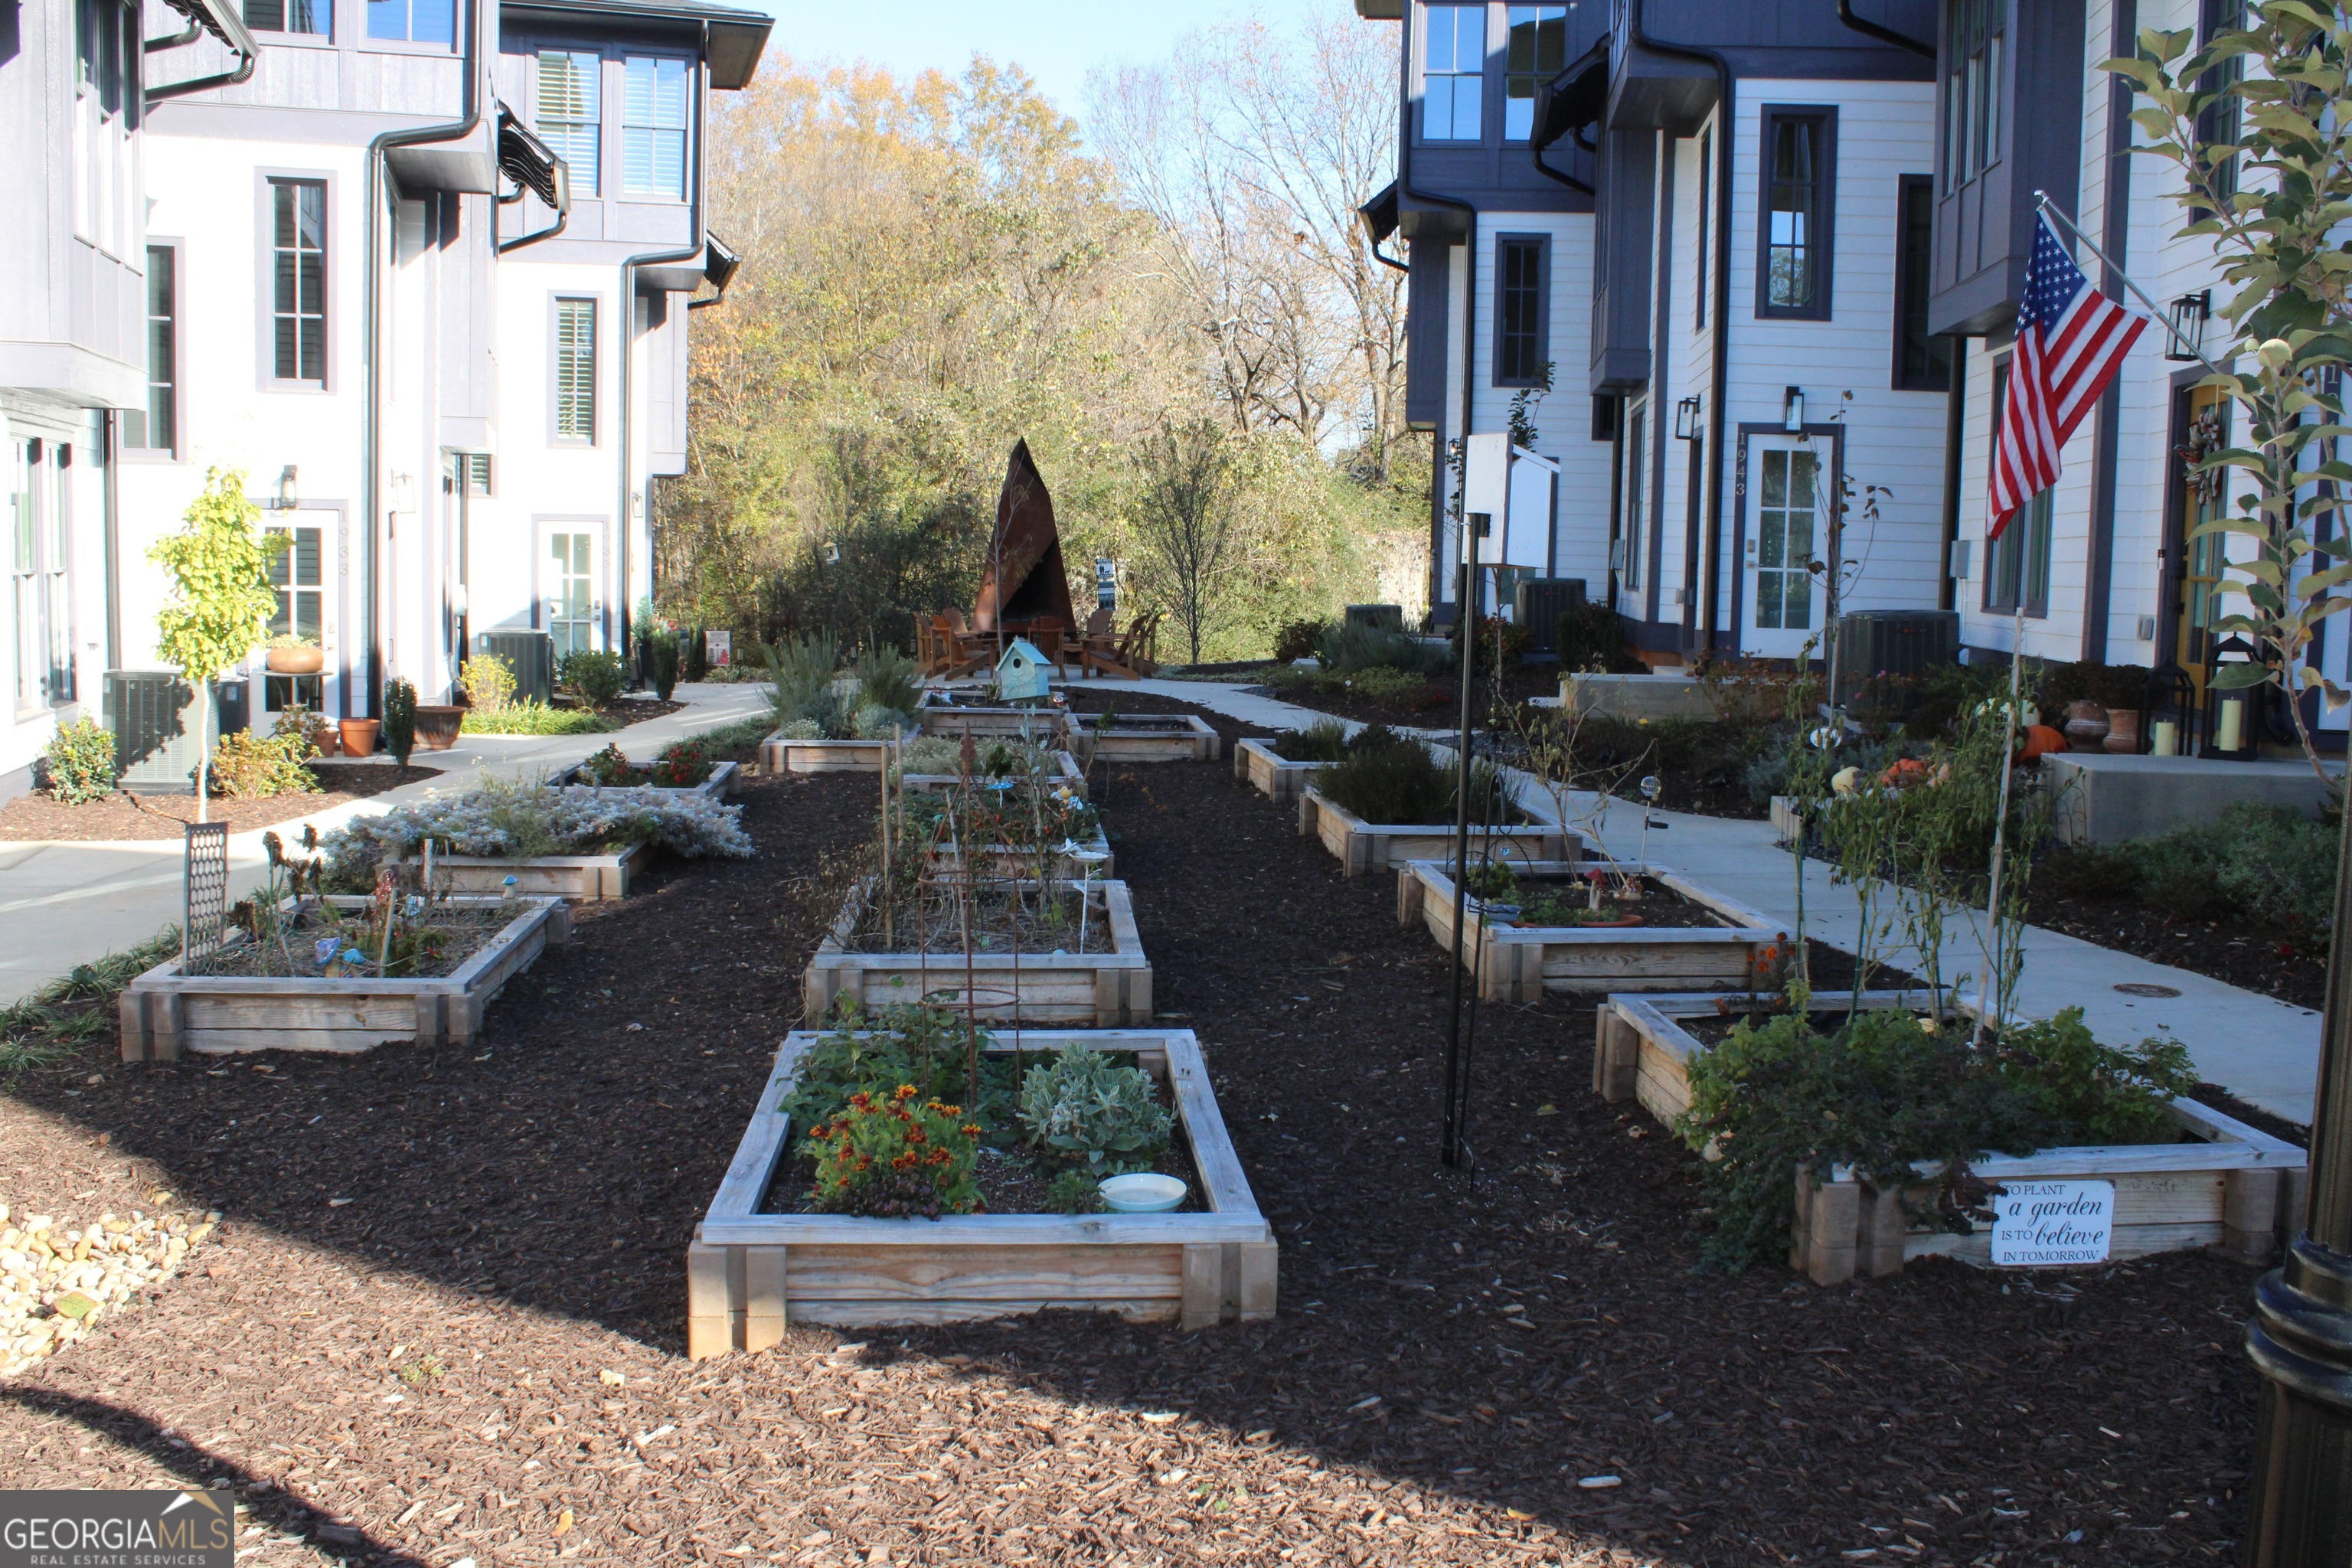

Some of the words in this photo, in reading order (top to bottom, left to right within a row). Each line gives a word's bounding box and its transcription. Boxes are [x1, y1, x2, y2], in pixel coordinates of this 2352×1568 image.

[1736, 433, 1746, 496] 1943
[340, 509, 348, 576] 1933
[2024, 1184, 2066, 1195] PLANT
[2009, 1201, 2022, 1216] a
[2027, 1191, 2102, 1227] garden
[2001, 1230, 2012, 1240] IS
[2014, 1230, 2033, 1240] TO
[2034, 1221, 2104, 1246] believe
[2003, 1251, 2017, 1262] IN
[2019, 1250, 2099, 1261] TOMORROW
